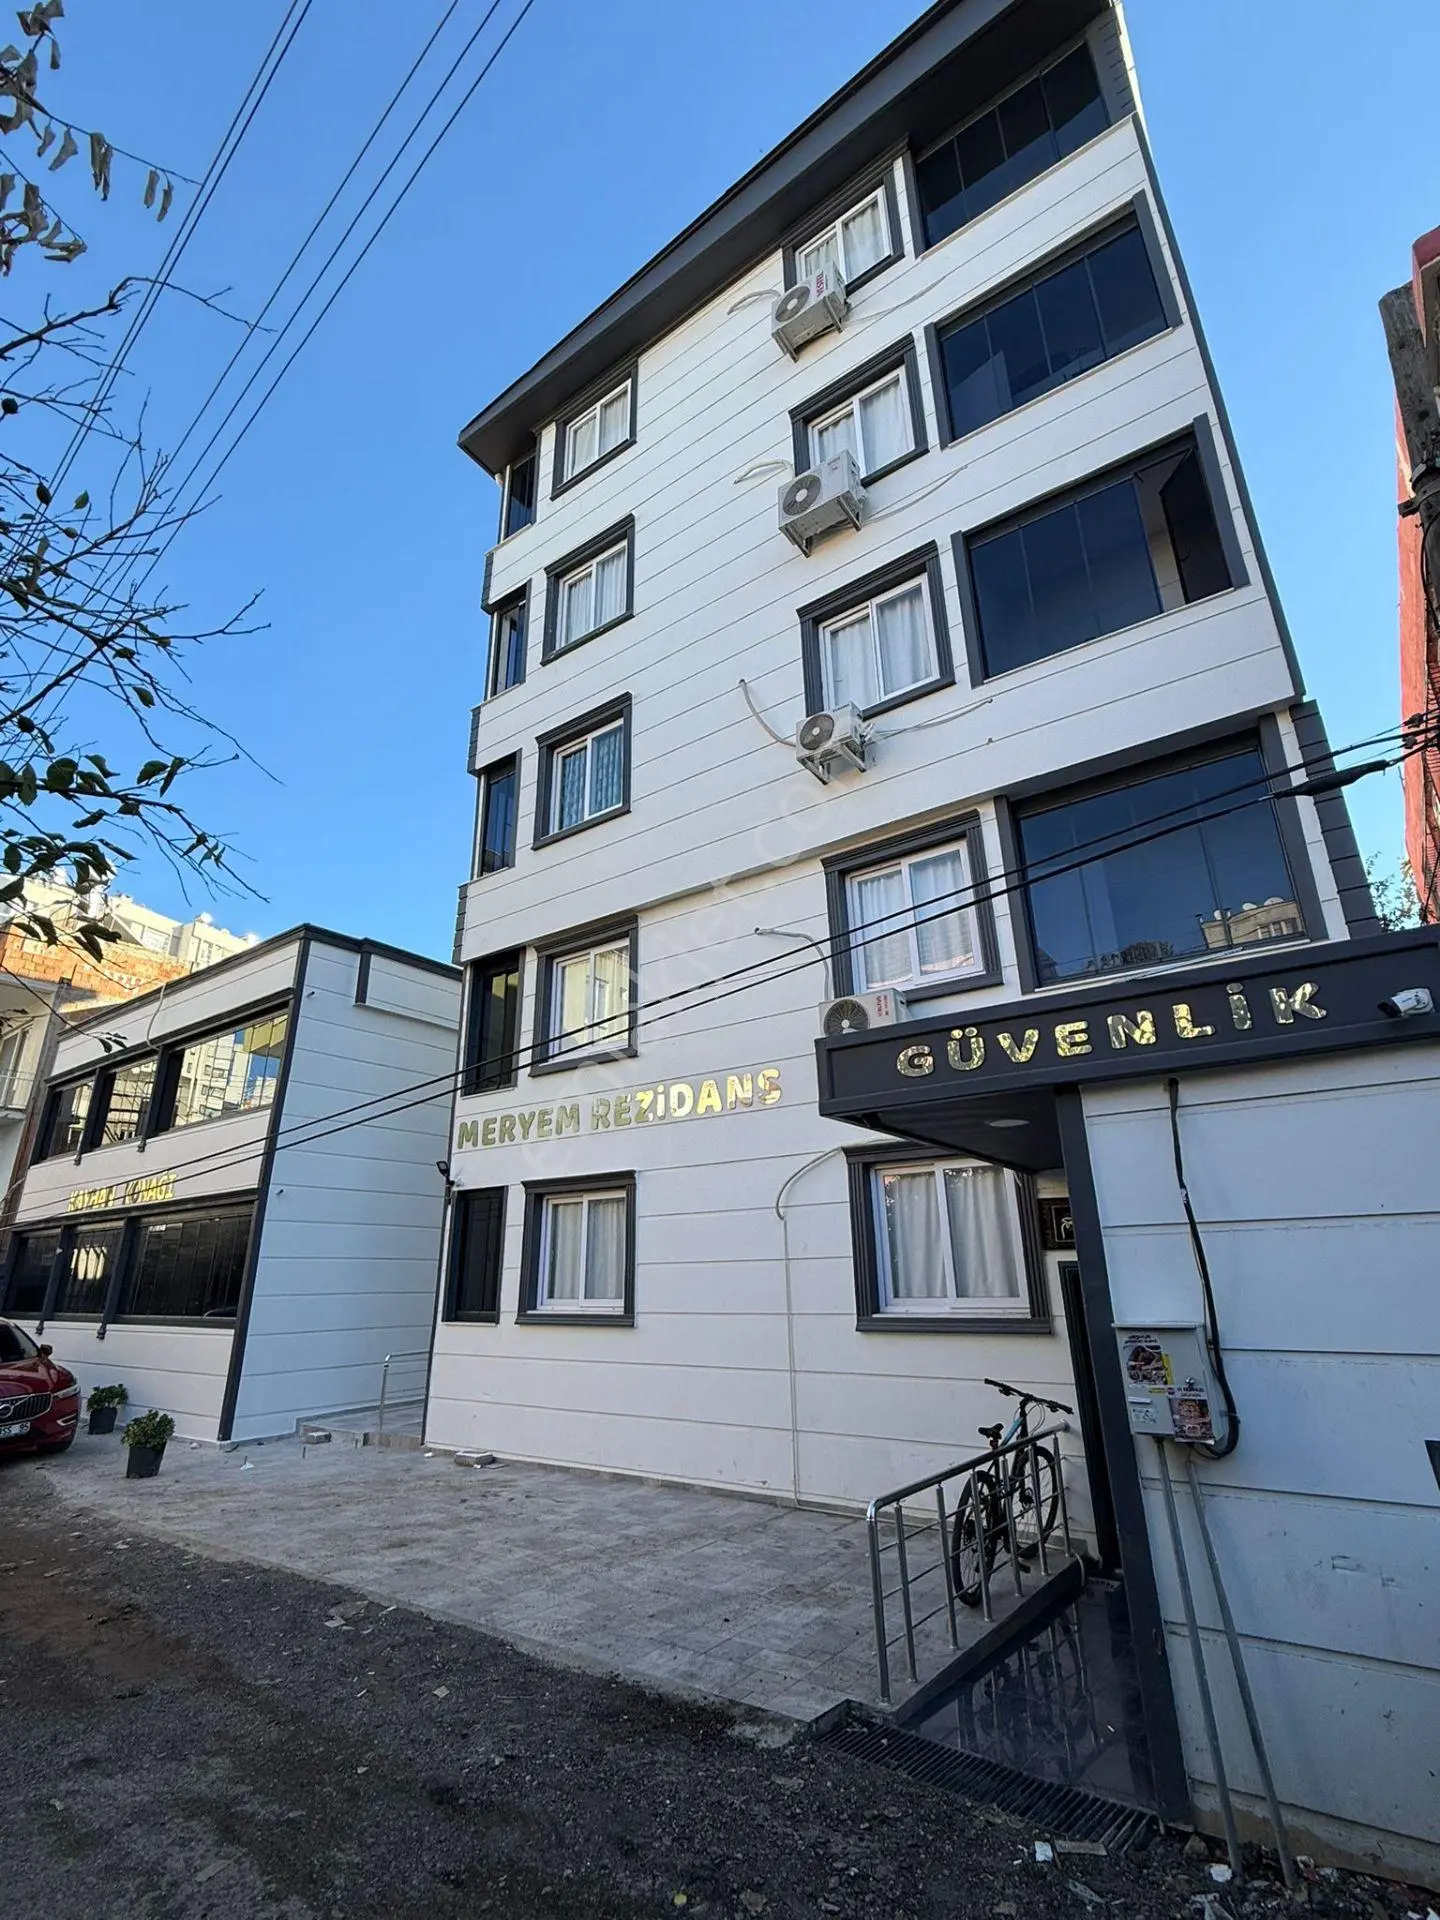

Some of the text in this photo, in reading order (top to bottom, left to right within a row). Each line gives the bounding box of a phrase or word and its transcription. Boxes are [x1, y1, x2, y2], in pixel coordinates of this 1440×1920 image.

[896, 981, 1328, 1078] GÜVENLİK
[457, 1068, 784, 1150] MERYEM REZİDANS
